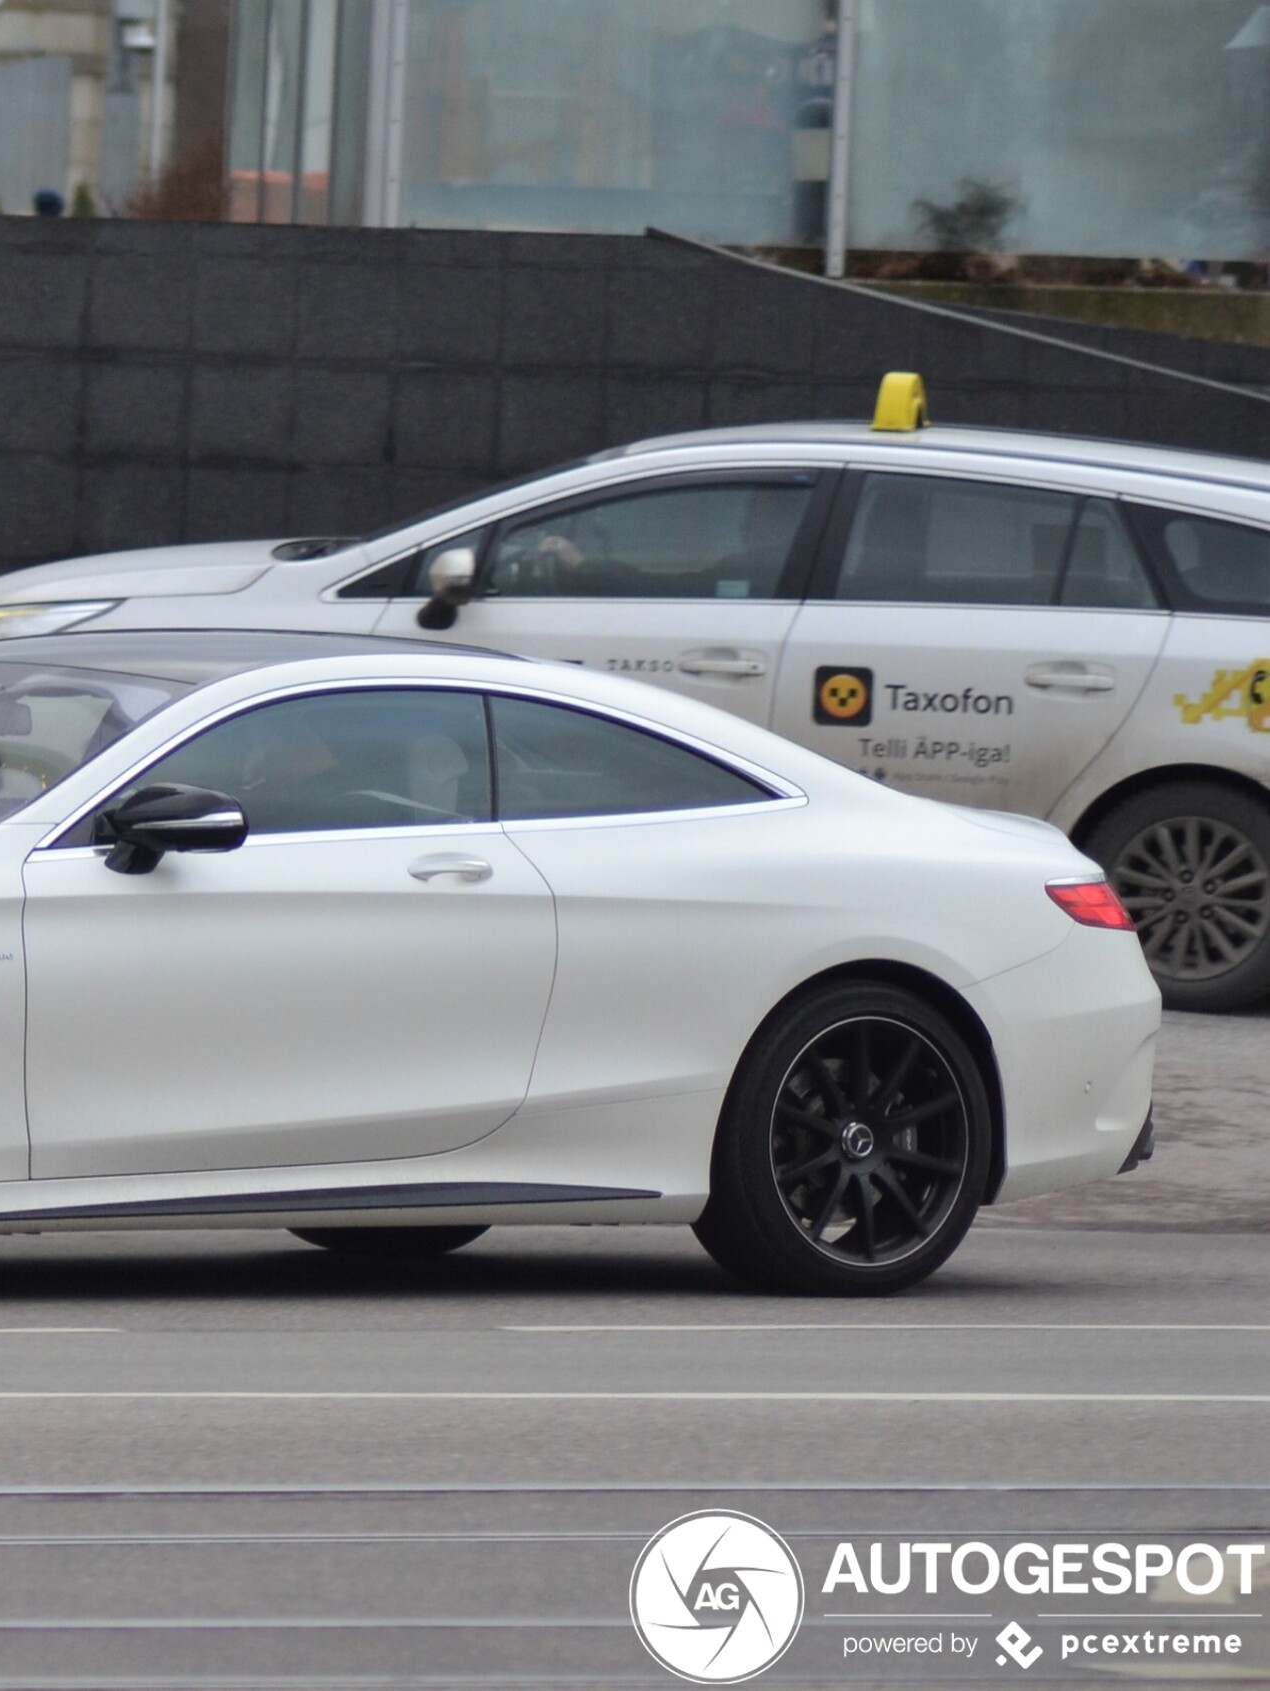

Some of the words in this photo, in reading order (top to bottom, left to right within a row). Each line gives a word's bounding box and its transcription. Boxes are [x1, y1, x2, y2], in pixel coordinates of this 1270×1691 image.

[607, 658, 675, 672] TAKSO
[885, 684, 1014, 716] Taxofon
[858, 738, 908, 759] Telli
[912, 734, 1011, 768] ÄPP-iga!
